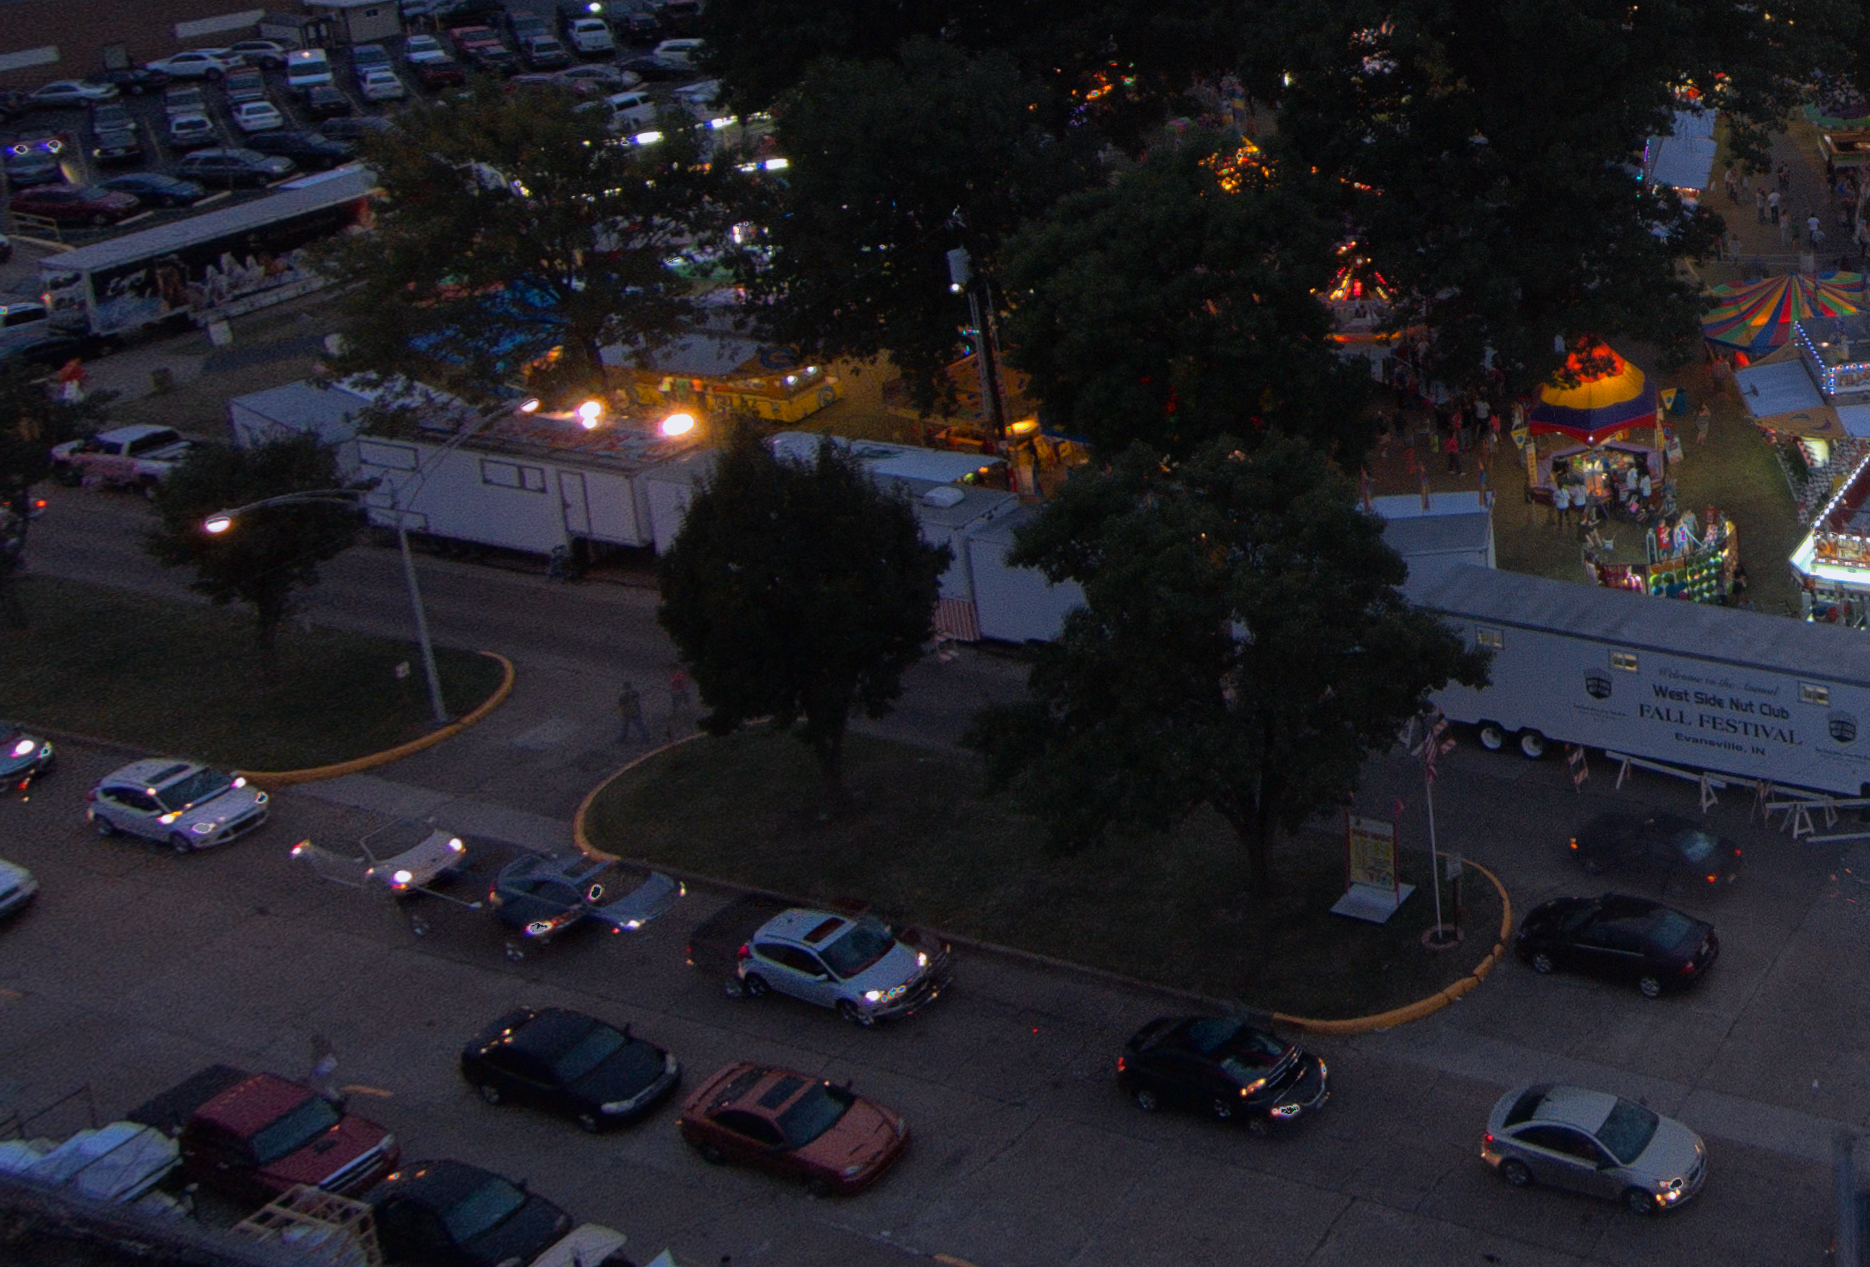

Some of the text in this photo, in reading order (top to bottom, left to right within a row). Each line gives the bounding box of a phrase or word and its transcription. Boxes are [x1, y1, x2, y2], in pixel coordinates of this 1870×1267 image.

[1652, 683, 1790, 719] West Side Nut Club
[1639, 703, 1692, 726] FALL
[1699, 713, 1803, 745] FESTIVAL
[1752, 746, 1766, 756] IN
